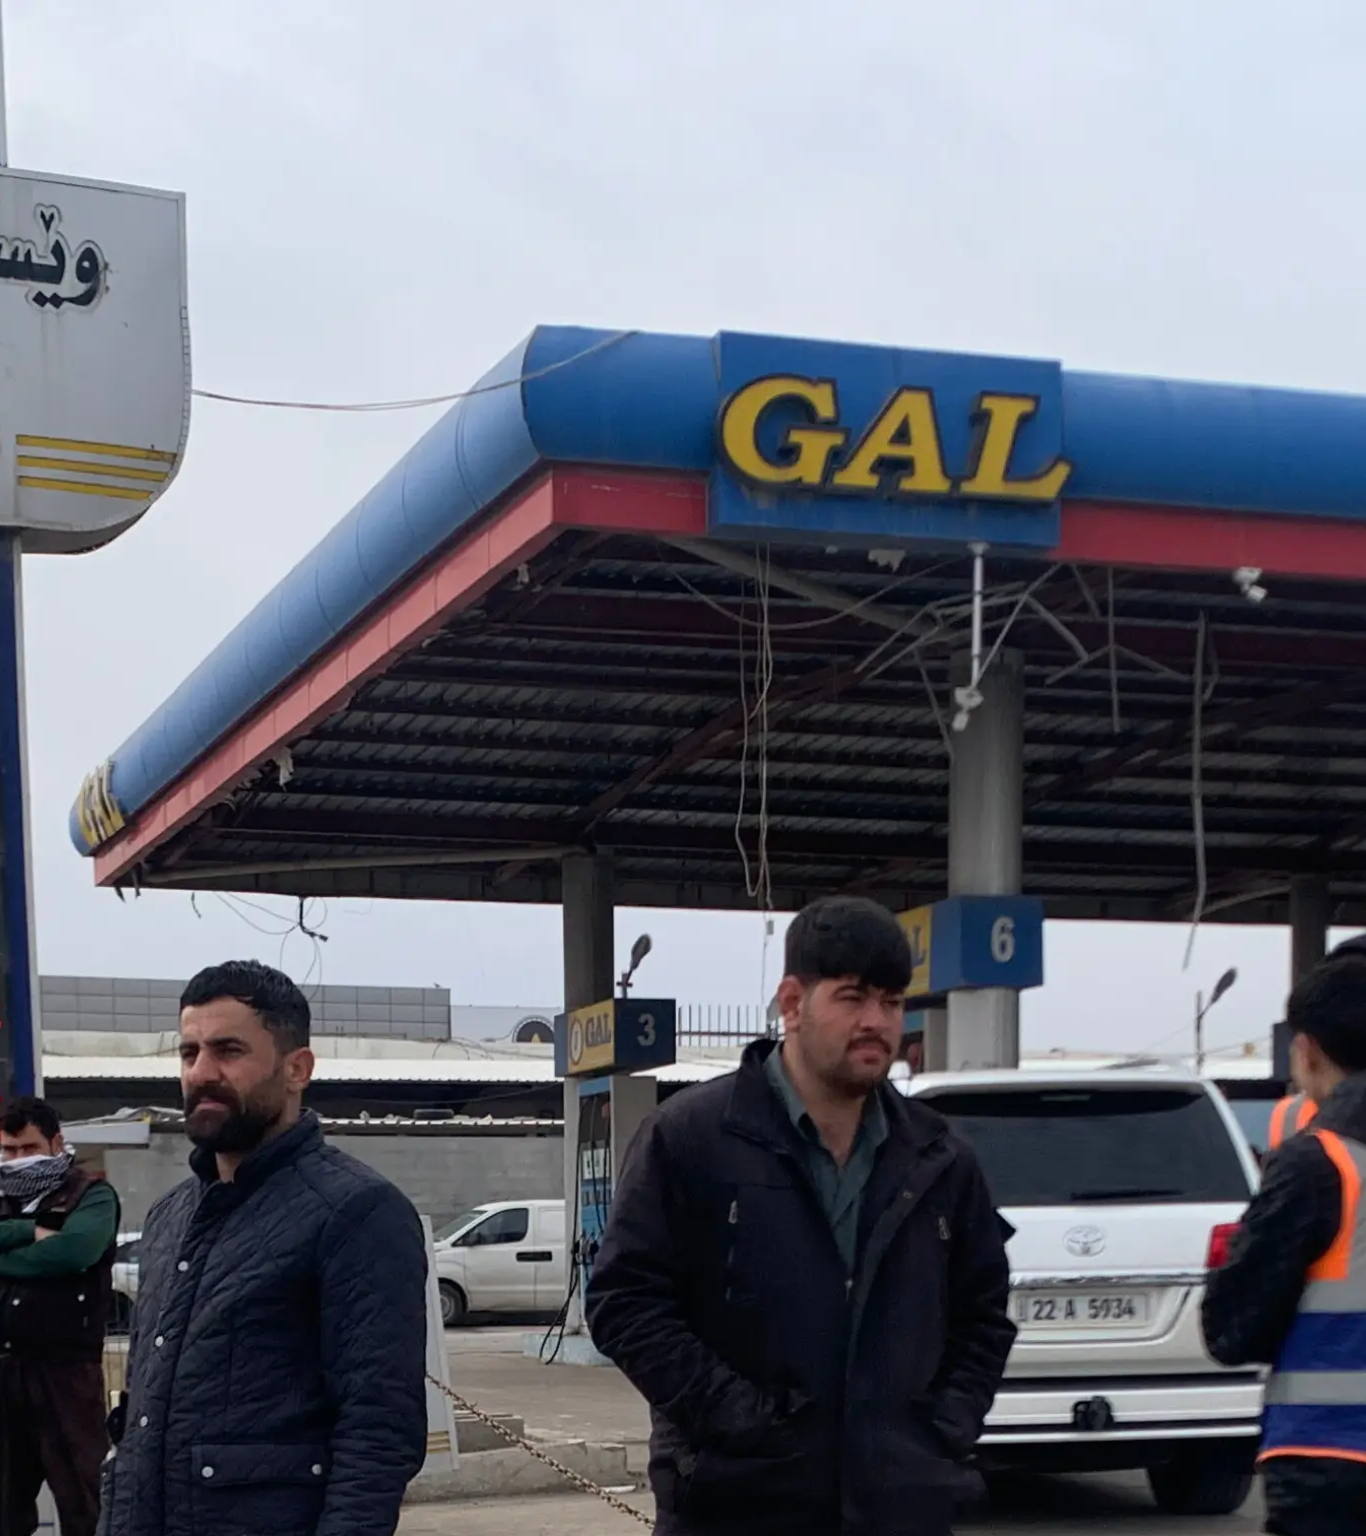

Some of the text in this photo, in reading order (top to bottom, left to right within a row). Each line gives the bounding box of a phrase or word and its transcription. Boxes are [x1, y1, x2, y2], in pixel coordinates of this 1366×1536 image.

[718, 372, 1072, 503] GAL
[990, 915, 1016, 964] 6
[585, 1013, 612, 1047] GAL
[637, 1013, 656, 1047] 3
[1032, 1298, 1057, 1321] 22
